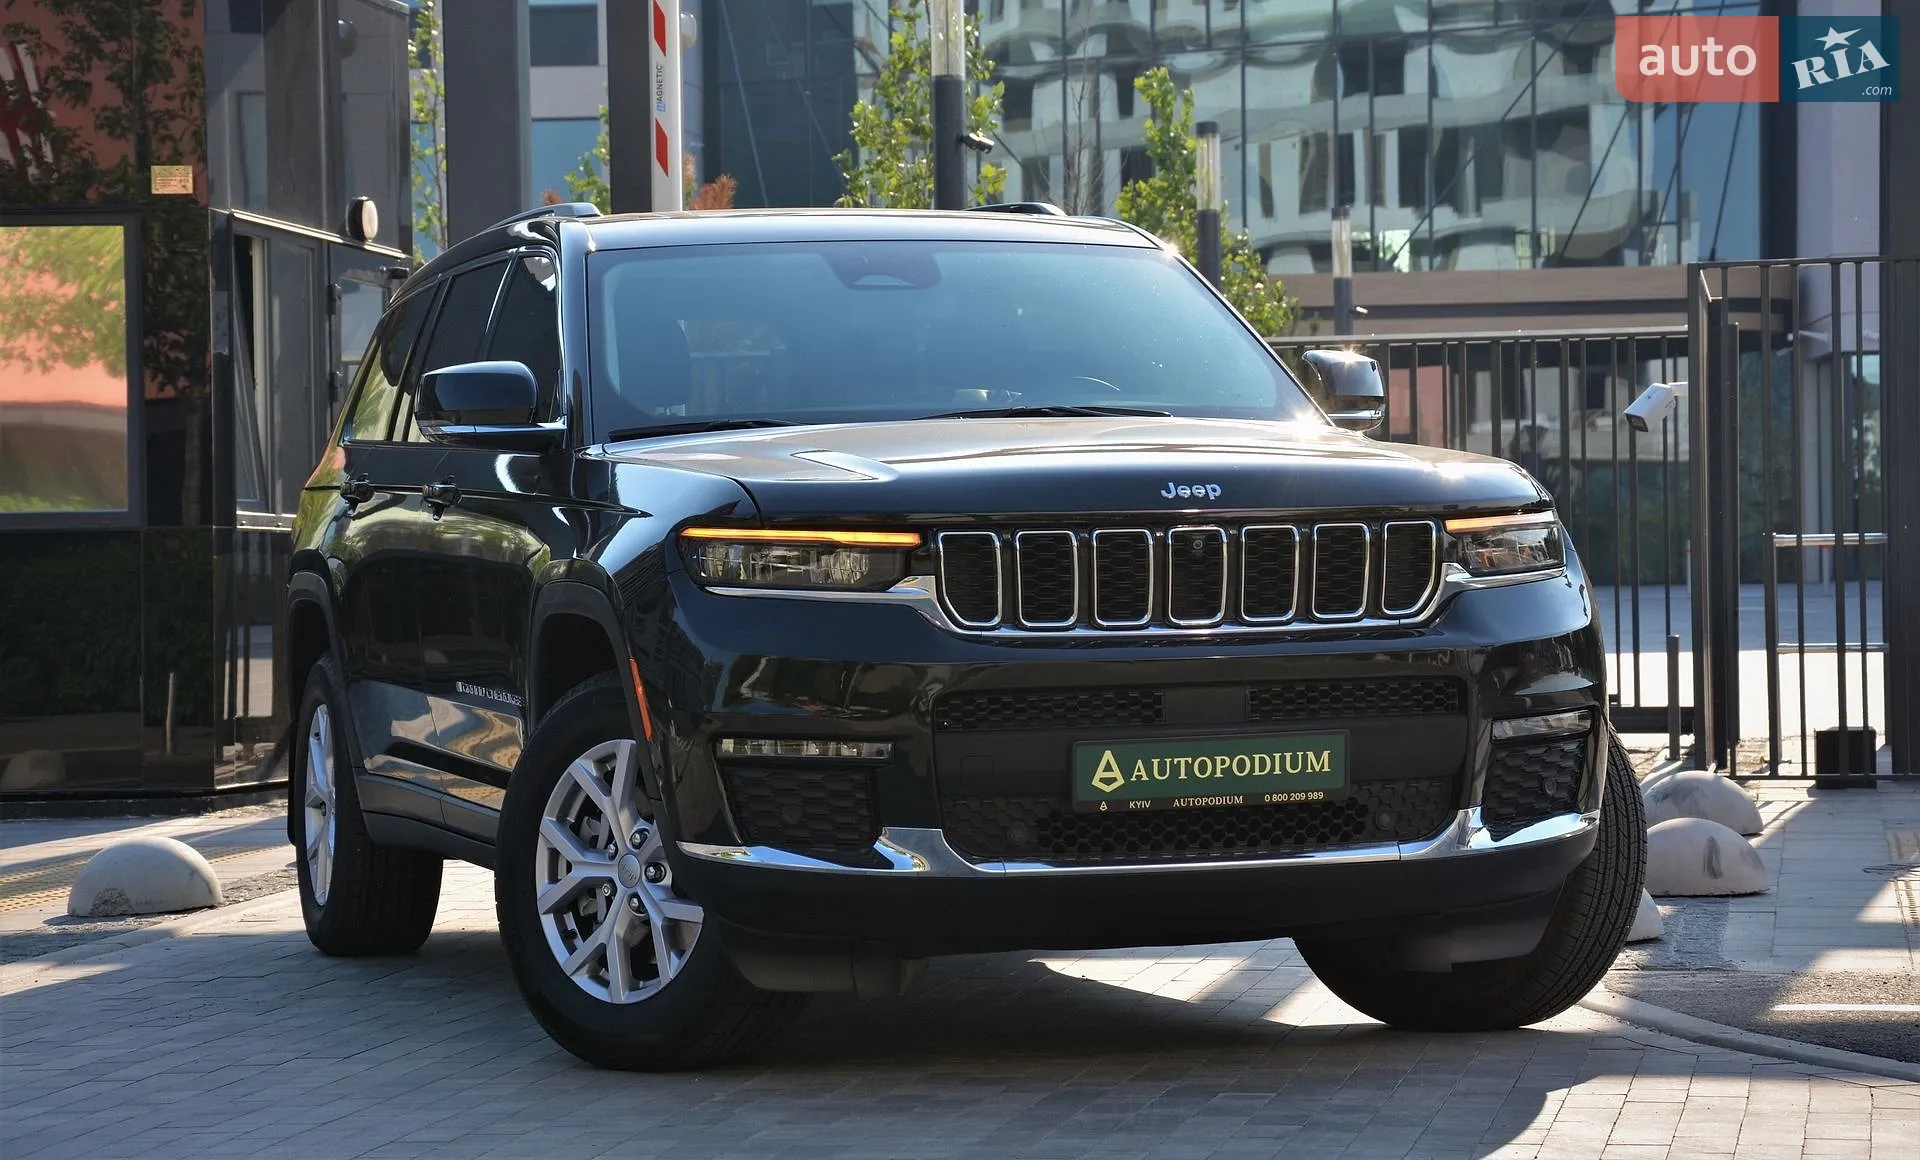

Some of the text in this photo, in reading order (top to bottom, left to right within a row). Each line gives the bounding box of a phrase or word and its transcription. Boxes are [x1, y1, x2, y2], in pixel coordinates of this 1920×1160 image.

[1160, 482, 1222, 500] Jeep
[1130, 750, 1332, 782] AUTOPODIUM
[1129, 800, 1151, 809] KYIV
[1173, 795, 1243, 808] AUTOPODIUM
[1272, 793, 1288, 803] 800
[1289, 792, 1306, 802] 209
[1307, 791, 1324, 801] 989
